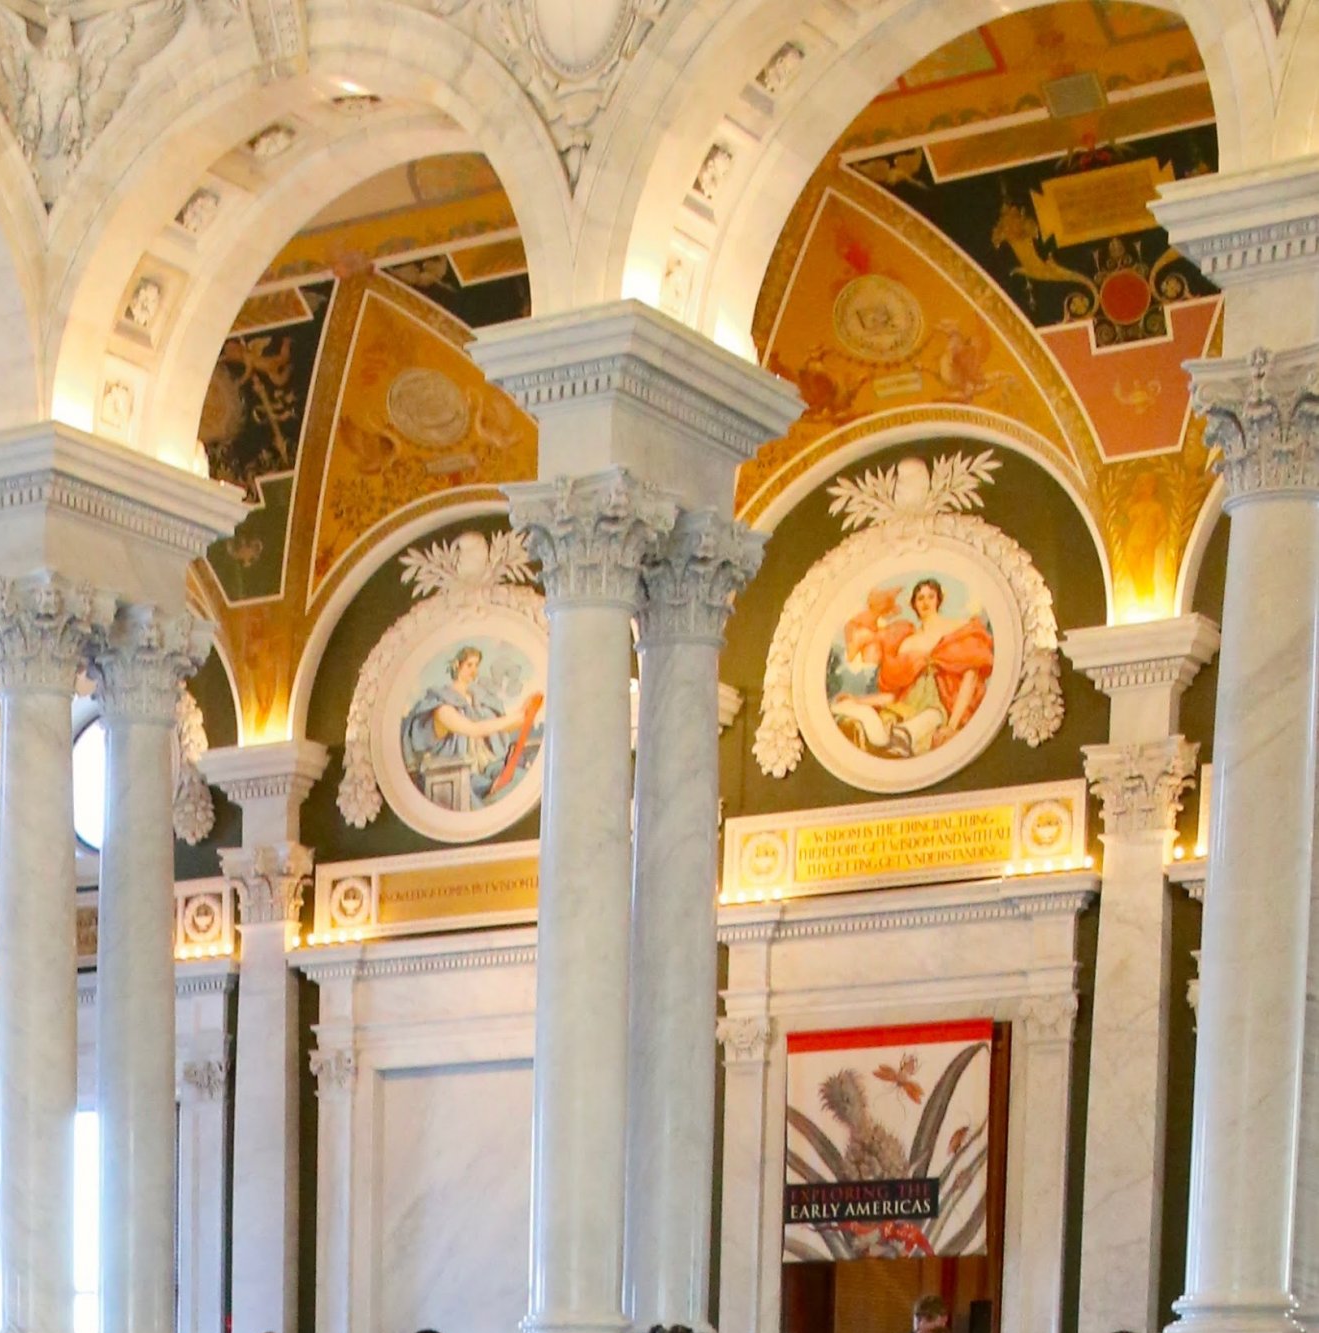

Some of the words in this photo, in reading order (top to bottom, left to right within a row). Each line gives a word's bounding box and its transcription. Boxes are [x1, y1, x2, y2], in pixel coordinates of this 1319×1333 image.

[813, 827, 861, 844] WISDOM
[876, 823, 893, 838] THE
[900, 815, 952, 836] PRINCIPAL
[798, 841, 859, 862] THEREFORE
[888, 832, 935, 852] WISDOM
[934, 831, 962, 847] AND
[962, 828, 993, 844] WITH
[791, 1185, 889, 1202] EXPLORING
[898, 1183, 930, 1199] THE
[790, 1201, 840, 1219] EARLY
[844, 1199, 931, 1217] AMERICAS
